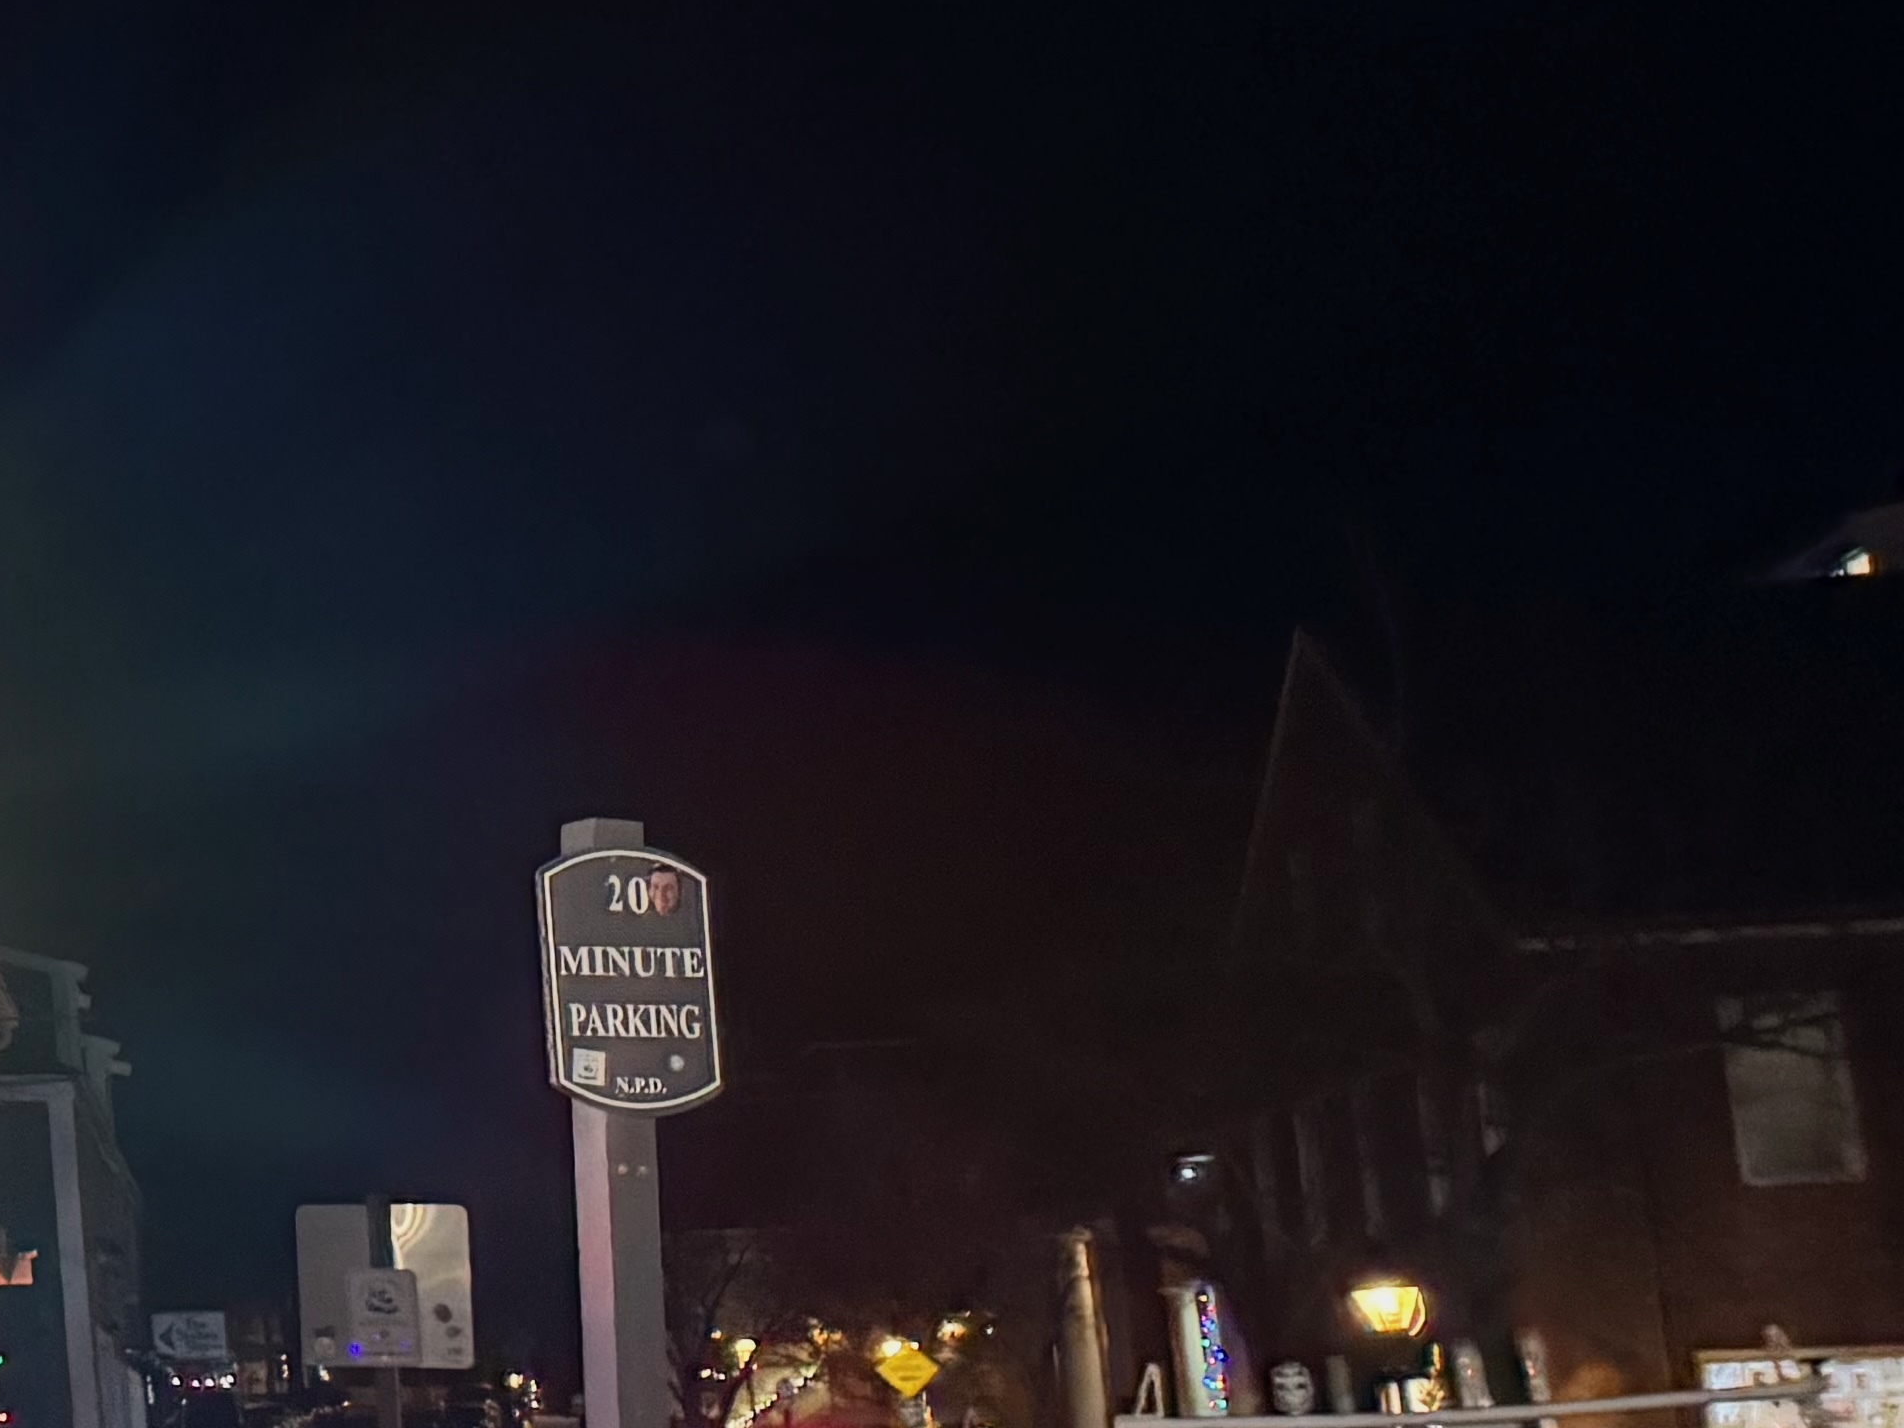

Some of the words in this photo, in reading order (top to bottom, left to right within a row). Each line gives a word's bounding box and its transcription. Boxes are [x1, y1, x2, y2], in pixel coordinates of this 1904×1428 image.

[607, 874, 649, 914] 20
[557, 946, 705, 979] MINUTE
[568, 1002, 702, 1040] PARKING
[614, 1075, 668, 1094] N.P.D.
